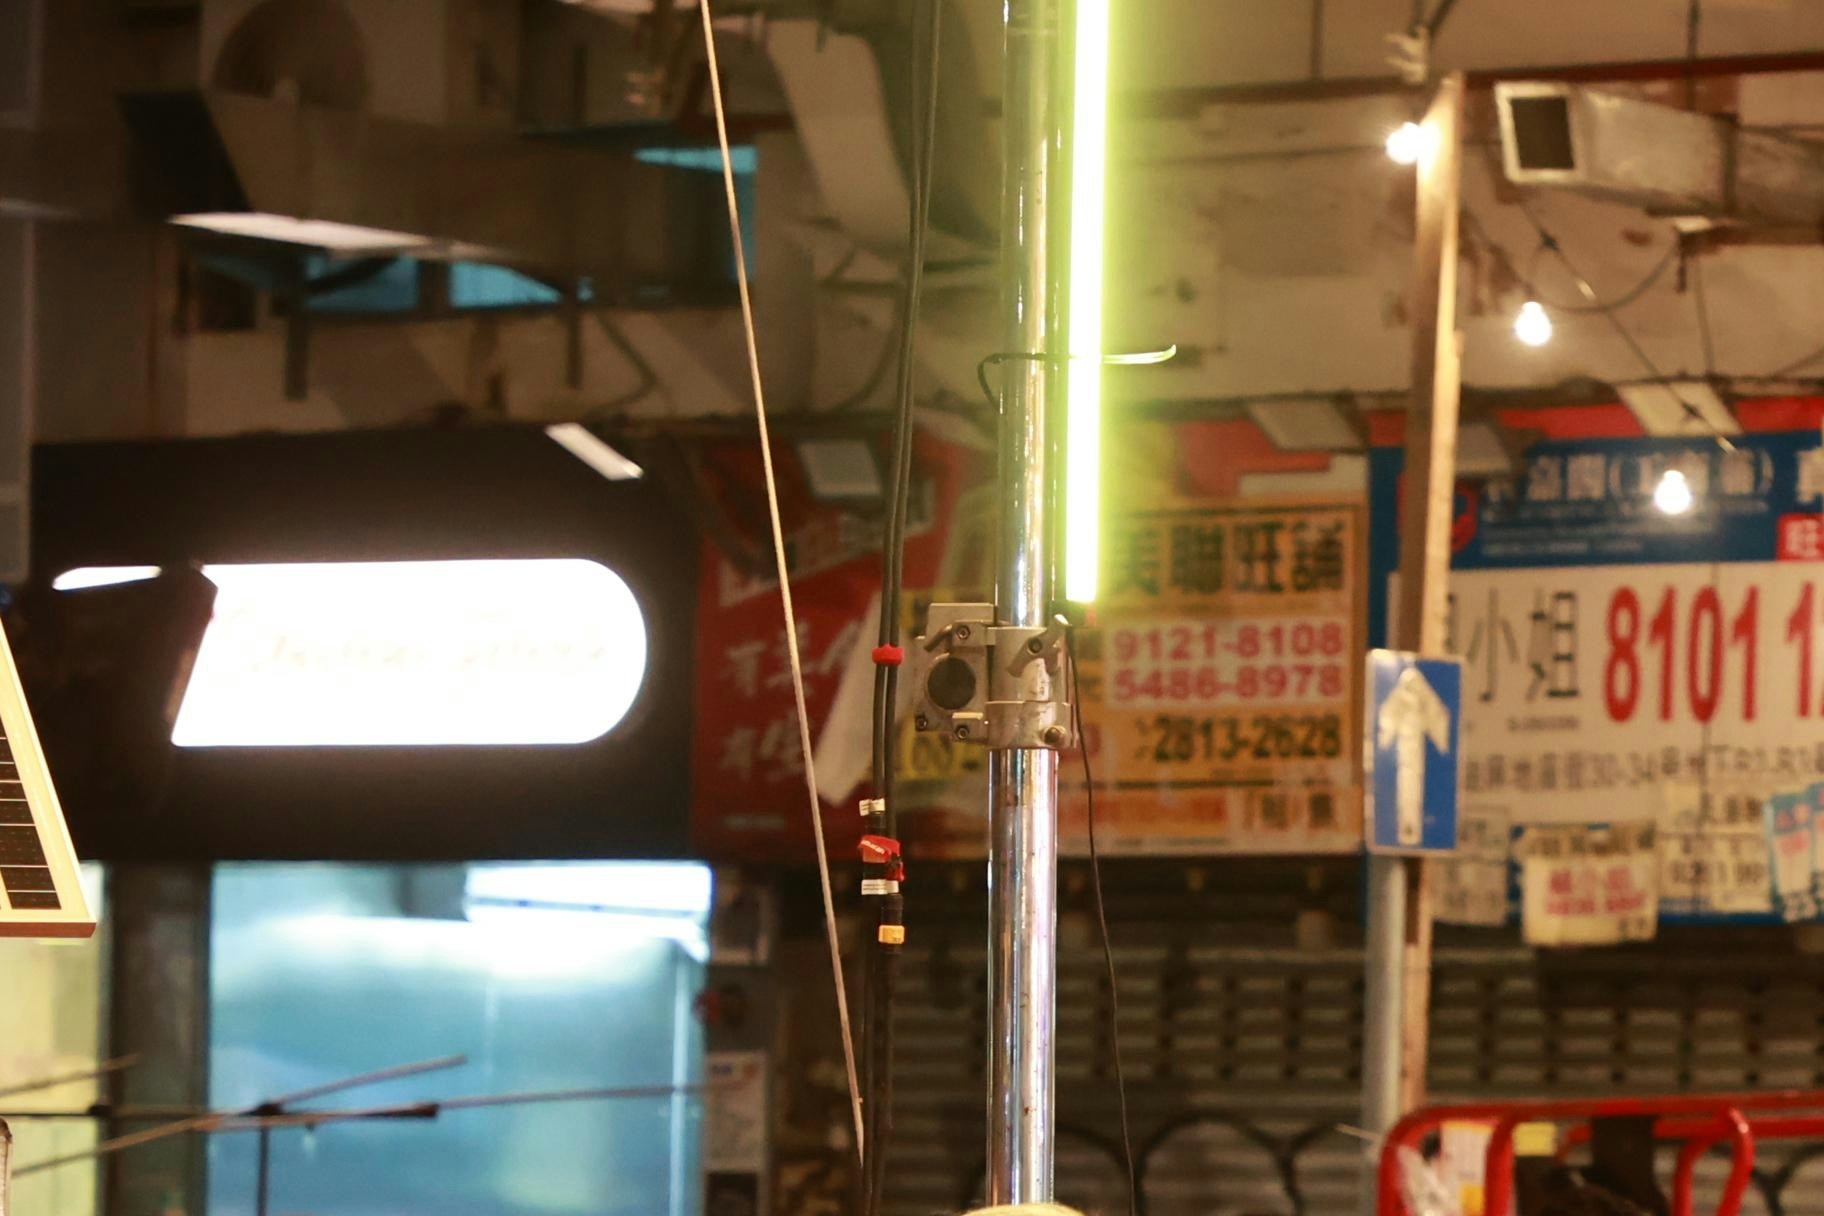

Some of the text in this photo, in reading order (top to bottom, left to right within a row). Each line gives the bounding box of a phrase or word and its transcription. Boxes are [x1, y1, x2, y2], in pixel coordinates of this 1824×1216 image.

[1113, 620, 1344, 663] 9121-8108
[1604, 586, 1757, 724] 8101
[1113, 663, 1344, 703] 5486-8978
[1152, 713, 1342, 763] 2813-2628
